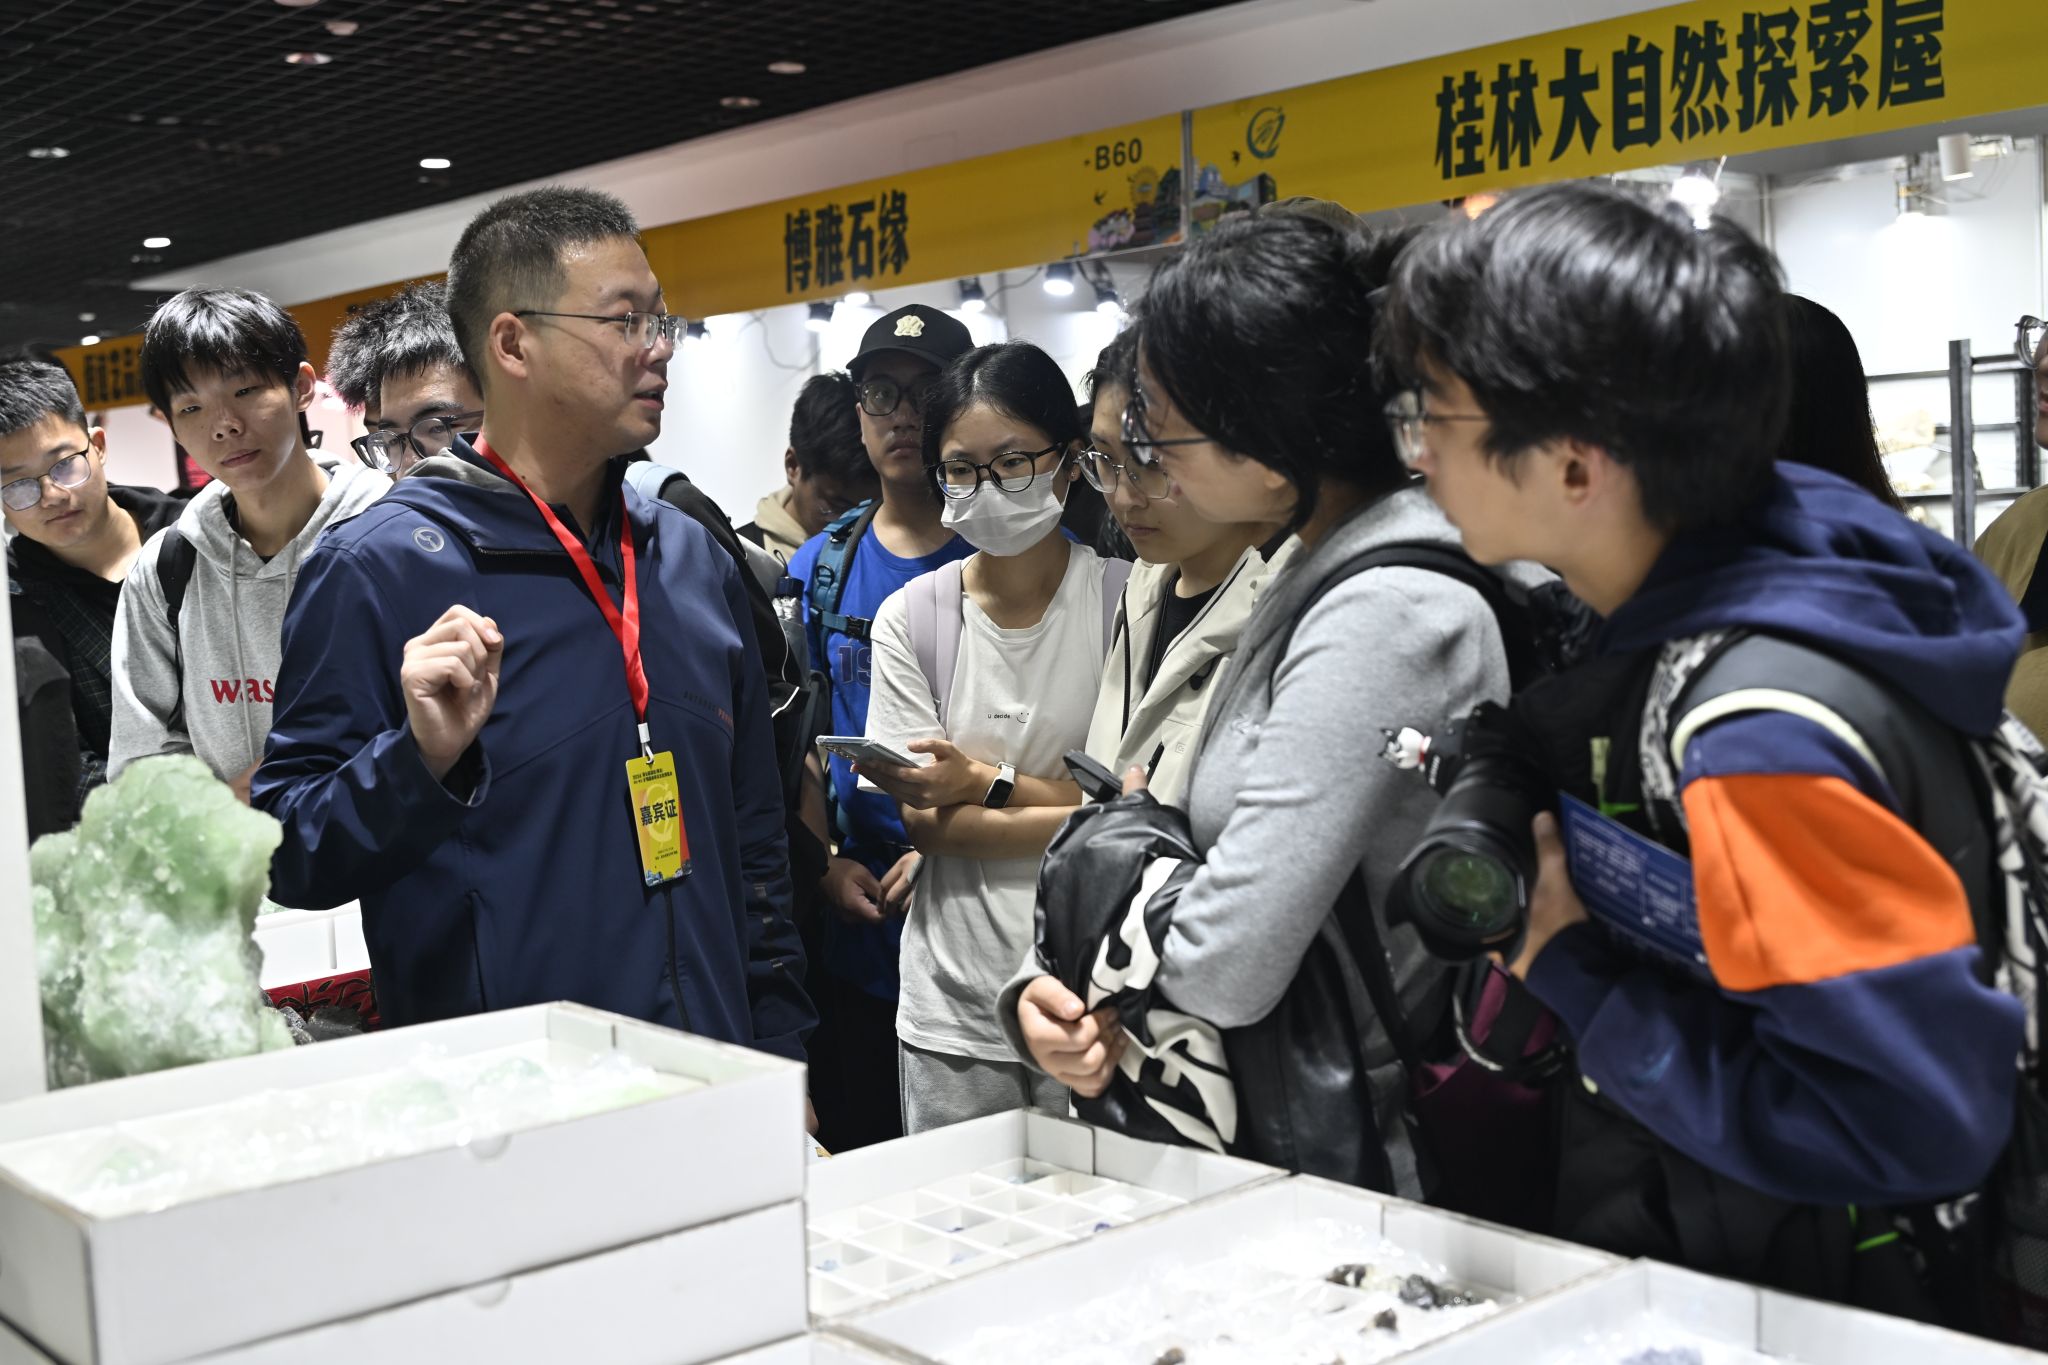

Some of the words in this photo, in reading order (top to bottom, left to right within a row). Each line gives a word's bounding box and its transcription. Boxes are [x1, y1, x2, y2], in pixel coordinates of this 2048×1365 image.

[1434, 0, 1946, 180] 桂林大自然探索屋
[1095, 138, 1142, 171] B60
[784, 188, 909, 293] 博雅石缘
[639, 799, 678, 827] 嘉宾证
